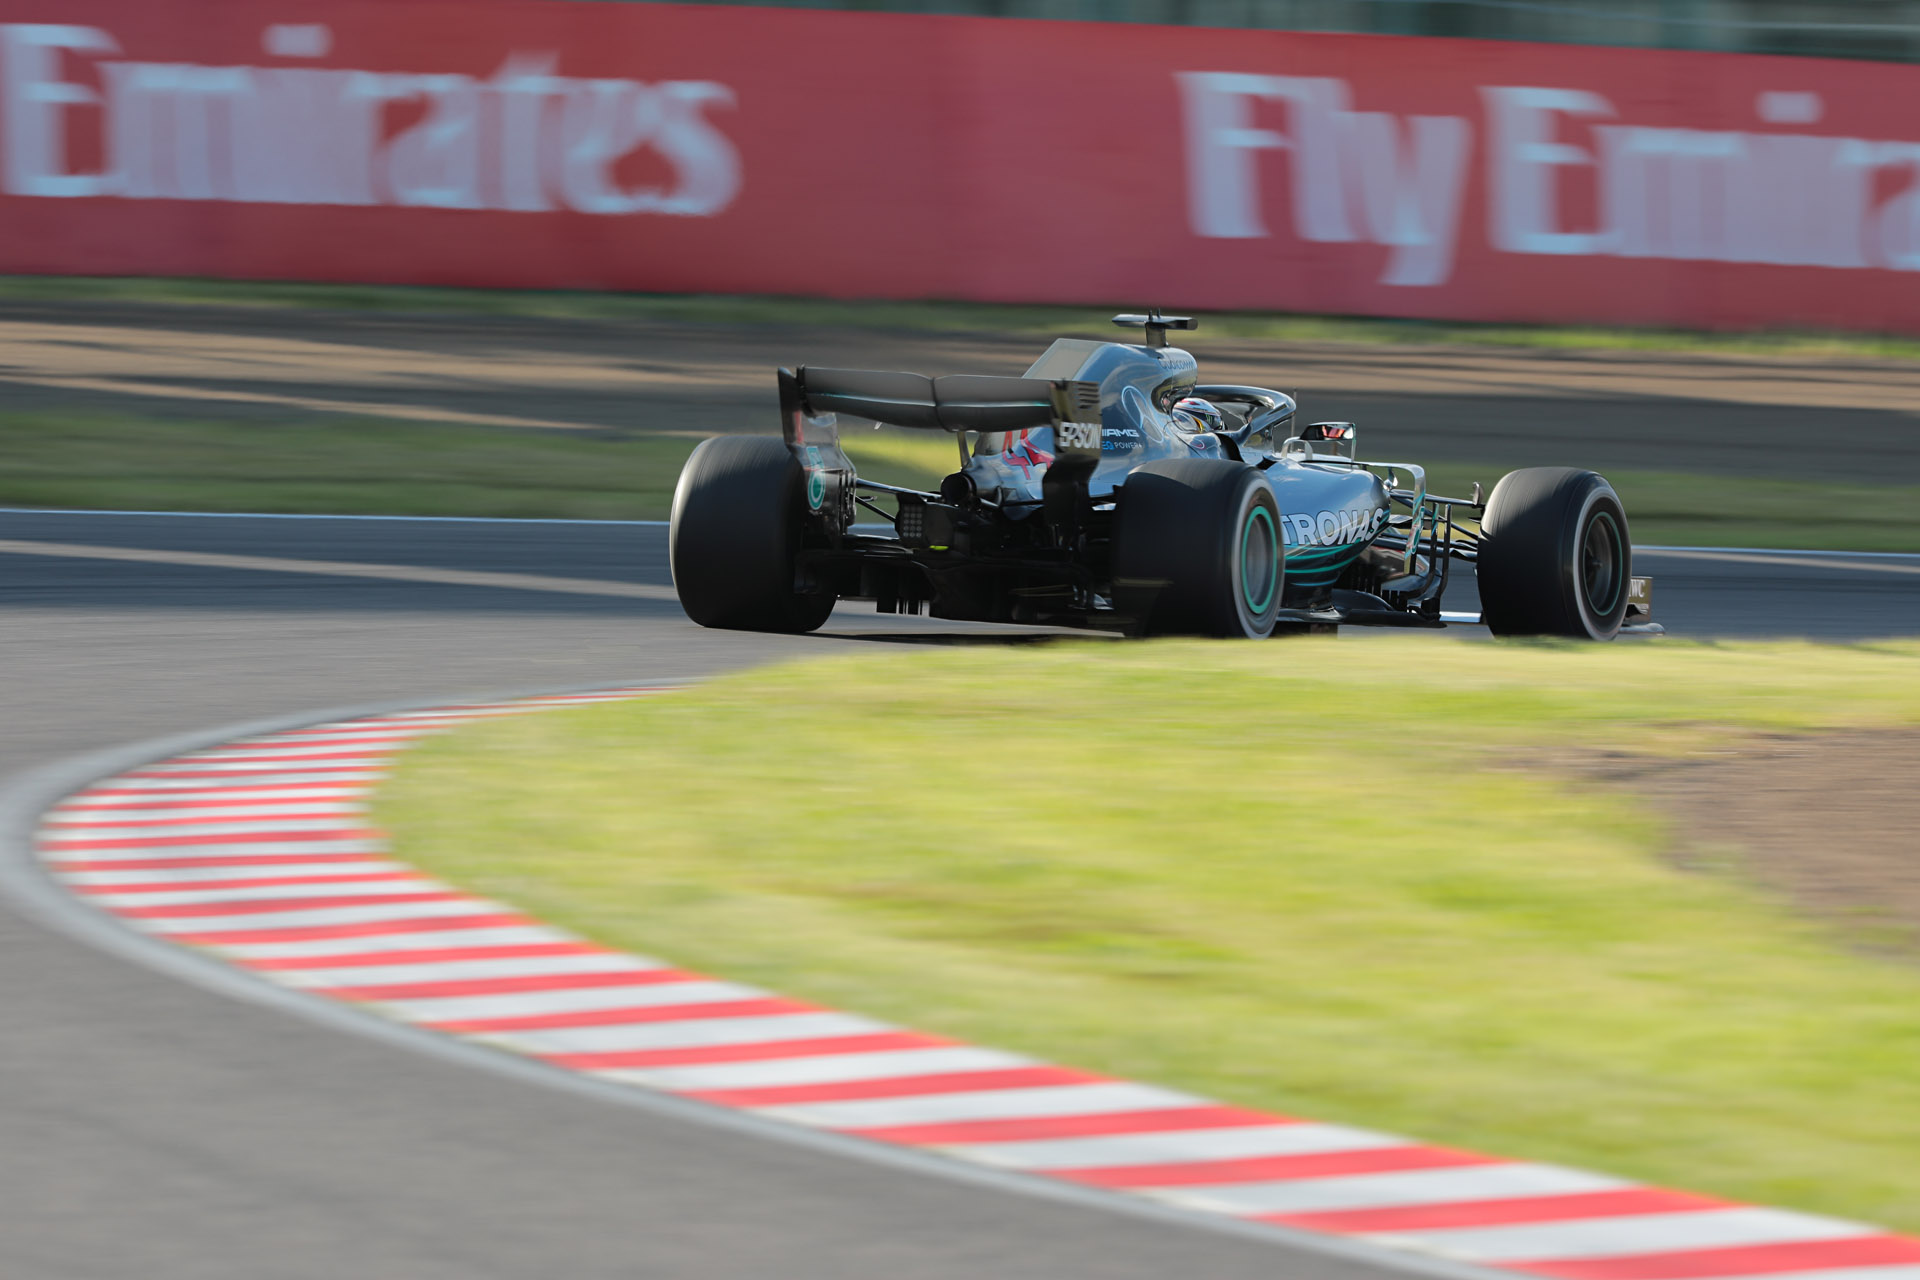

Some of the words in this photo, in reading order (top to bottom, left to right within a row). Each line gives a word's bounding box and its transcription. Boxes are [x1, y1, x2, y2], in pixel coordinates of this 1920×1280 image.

[0, 23, 741, 217] Emirates
[1174, 70, 1472, 285] Fly
[1059, 421, 1102, 449] EPSON
